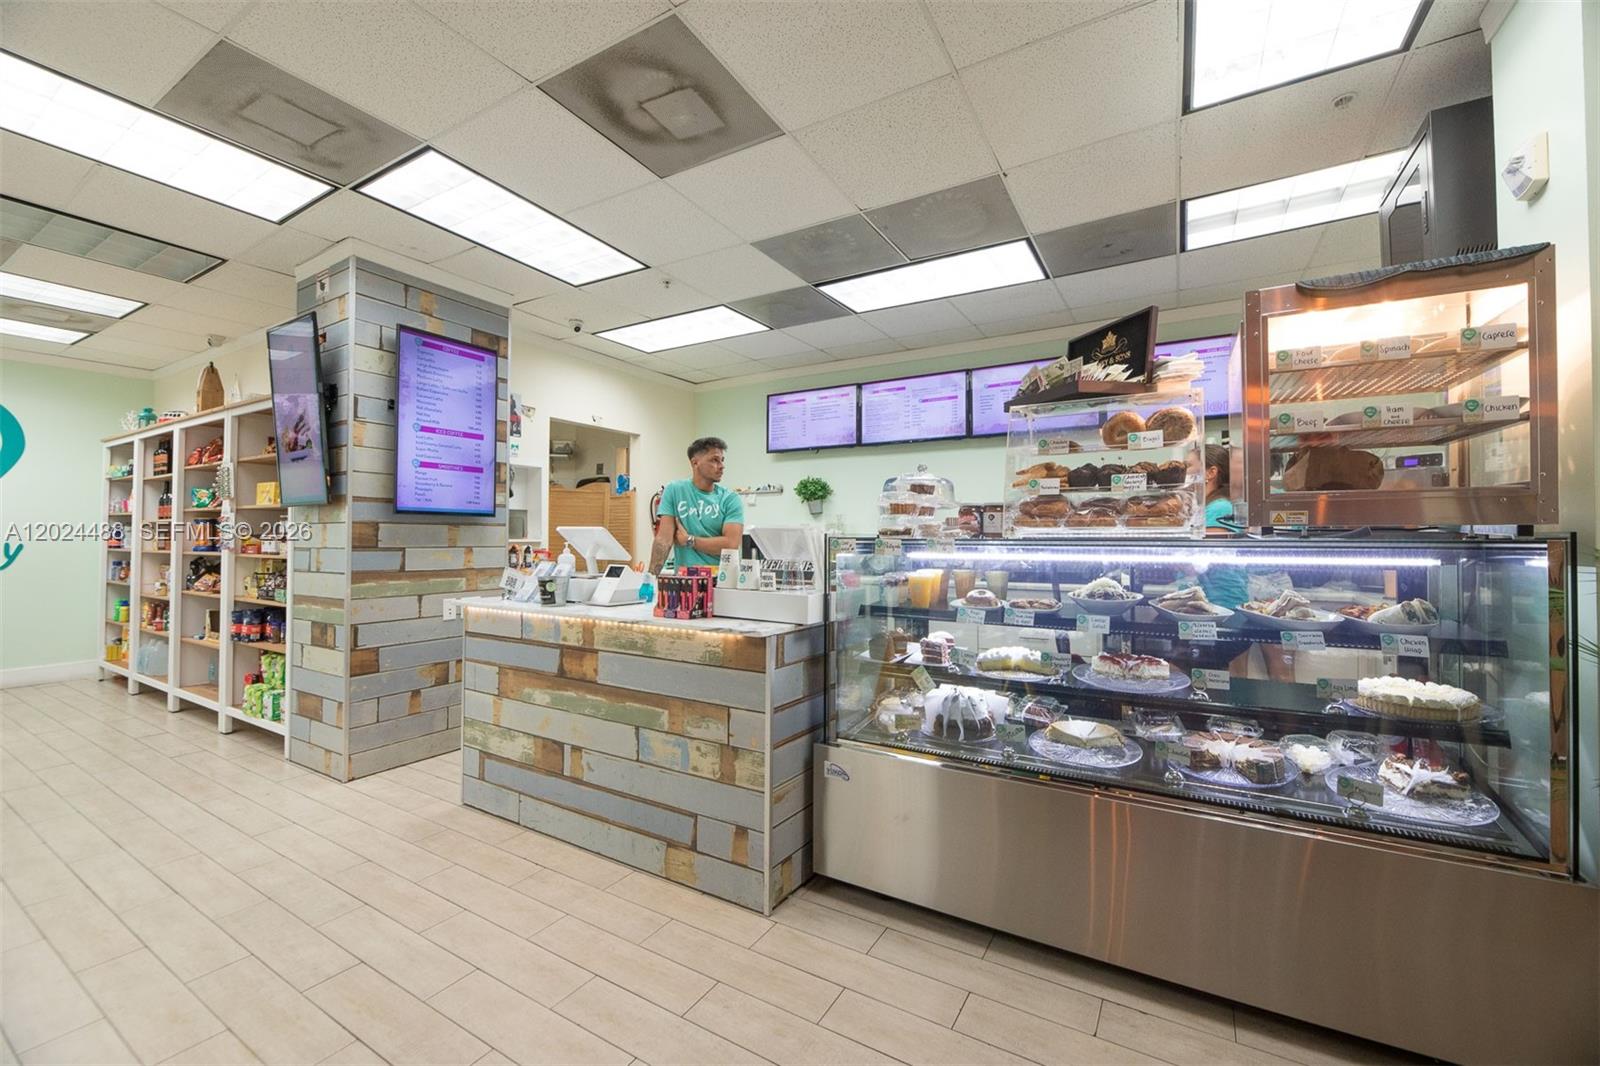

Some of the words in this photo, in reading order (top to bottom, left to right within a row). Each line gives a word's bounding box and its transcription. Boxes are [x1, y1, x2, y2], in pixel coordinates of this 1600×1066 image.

[1482, 330, 1515, 340] Caprese
[1380, 343, 1410, 354] Spinach
[1484, 403, 1518, 412] Chicken
